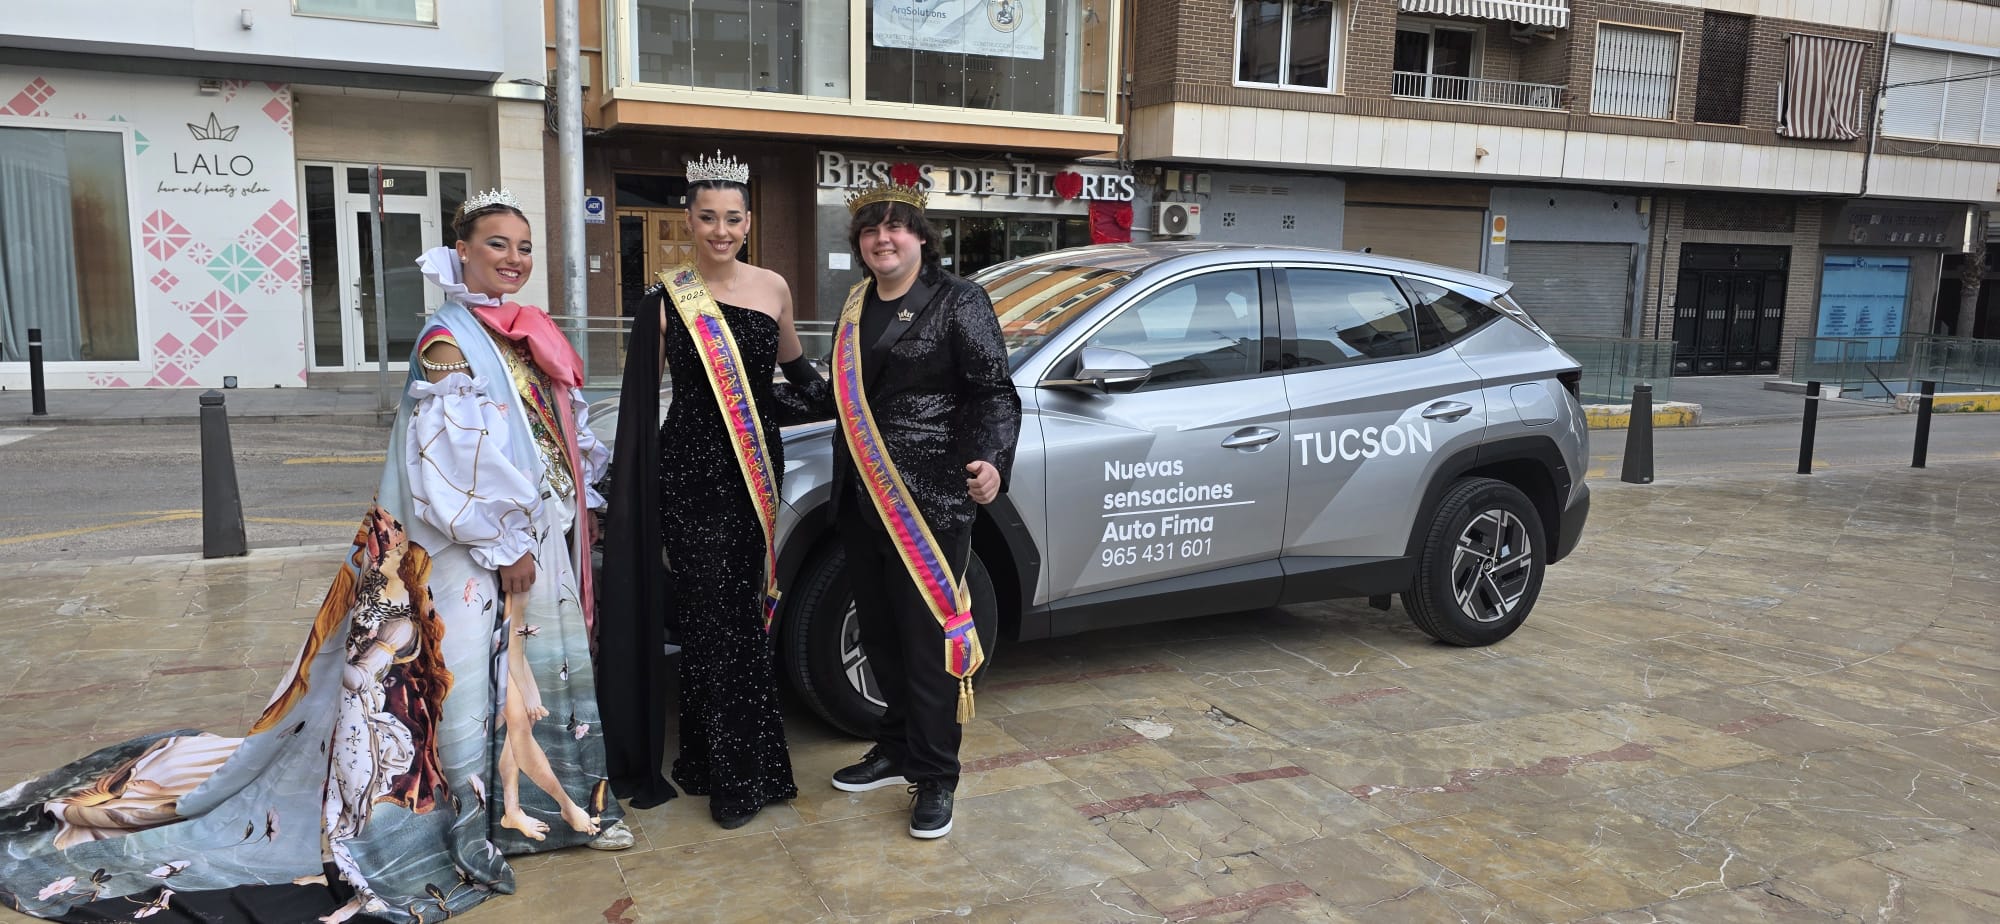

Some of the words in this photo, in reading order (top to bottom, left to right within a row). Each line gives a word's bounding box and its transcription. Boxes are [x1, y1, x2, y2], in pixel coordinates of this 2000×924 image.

[173, 151, 254, 177] LALO
[818, 150, 935, 193] BESS
[953, 166, 999, 195] DE
[1013, 162, 1136, 202] FLRES
[680, 289, 704, 304] 2025
[707, 335, 743, 408] REINA
[1294, 422, 1433, 466] TUCSON
[1104, 459, 1184, 482] Nuevas
[1103, 481, 1233, 510] sensaciones
[1101, 519, 1156, 543] Auto
[1161, 514, 1214, 538] Fima
[1101, 545, 1137, 568] 965
[1141, 541, 1174, 563] 431
[1180, 537, 1212, 558] 601
